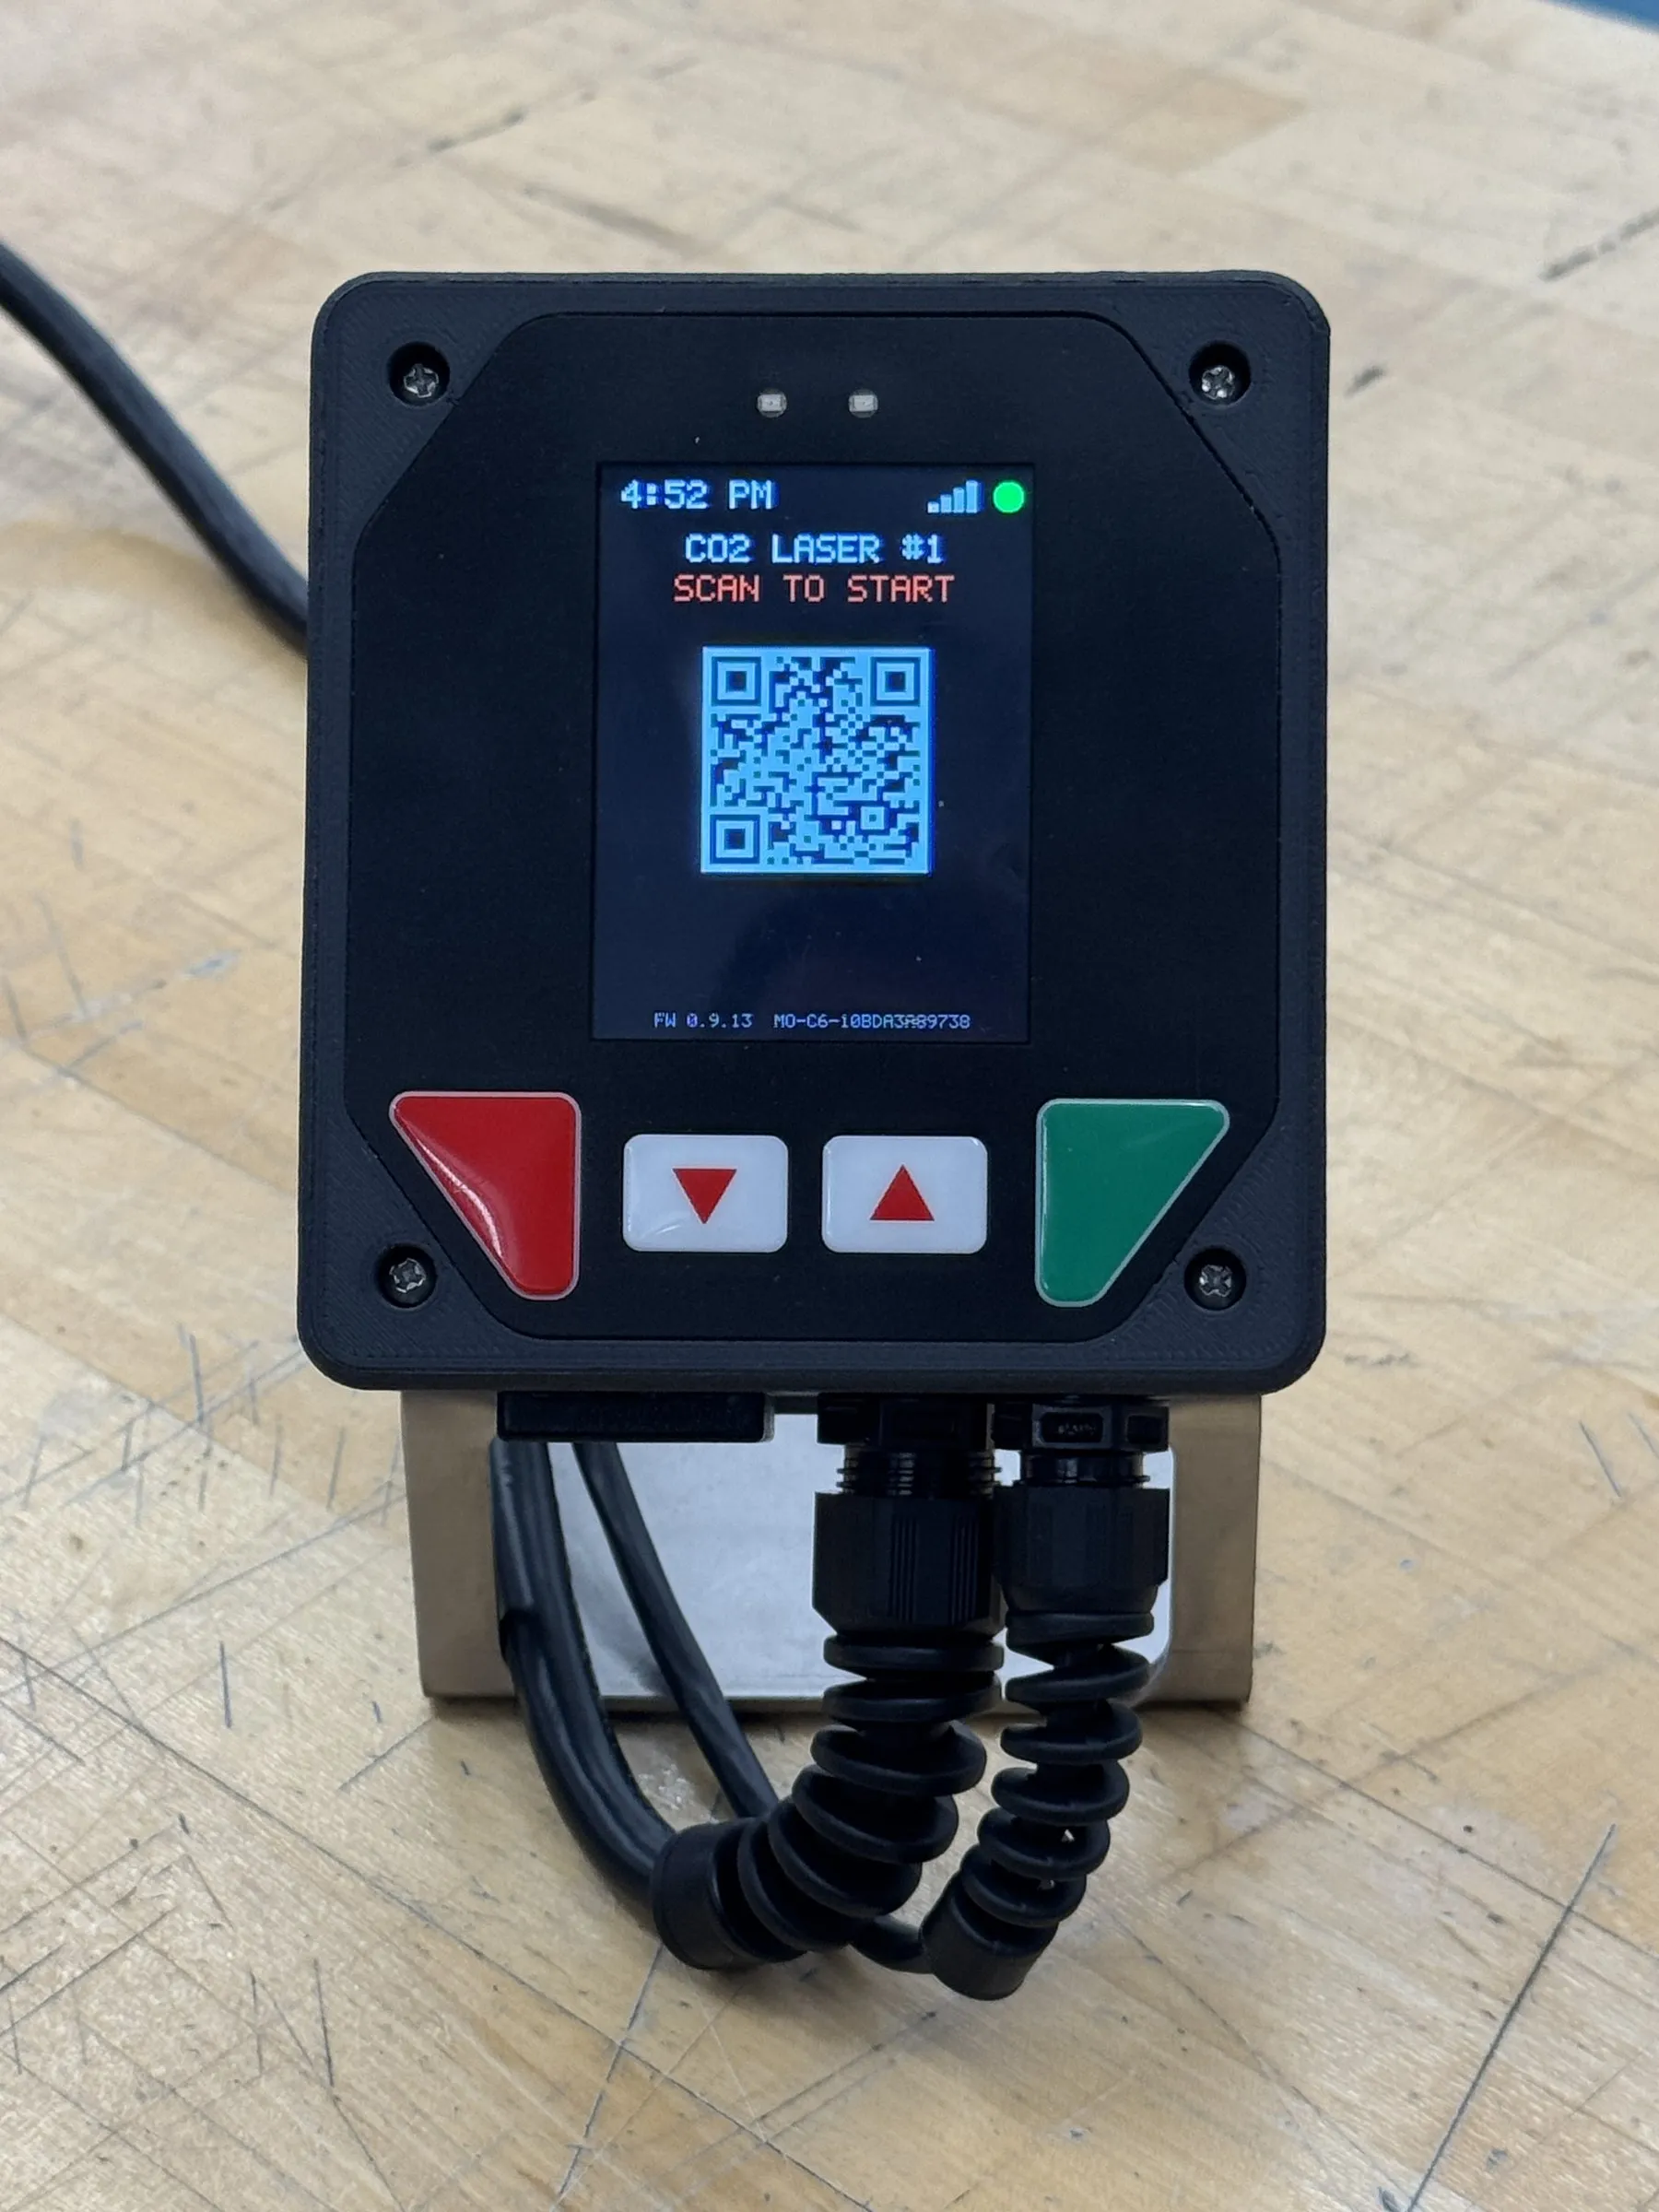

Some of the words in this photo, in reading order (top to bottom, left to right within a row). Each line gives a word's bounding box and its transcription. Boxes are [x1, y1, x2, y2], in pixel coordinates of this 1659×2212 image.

[621, 478, 708, 509] 4:52
[729, 479, 776, 509] PM
[685, 533, 751, 563] CO2
[771, 534, 880, 564] LASER
[901, 534, 944, 564] #1
[674, 574, 760, 602] SCAN
[783, 575, 825, 602] TO
[847, 574, 955, 602] START
[653, 1011, 677, 1029] FW
[686, 1011, 754, 1029] 0.9.13
